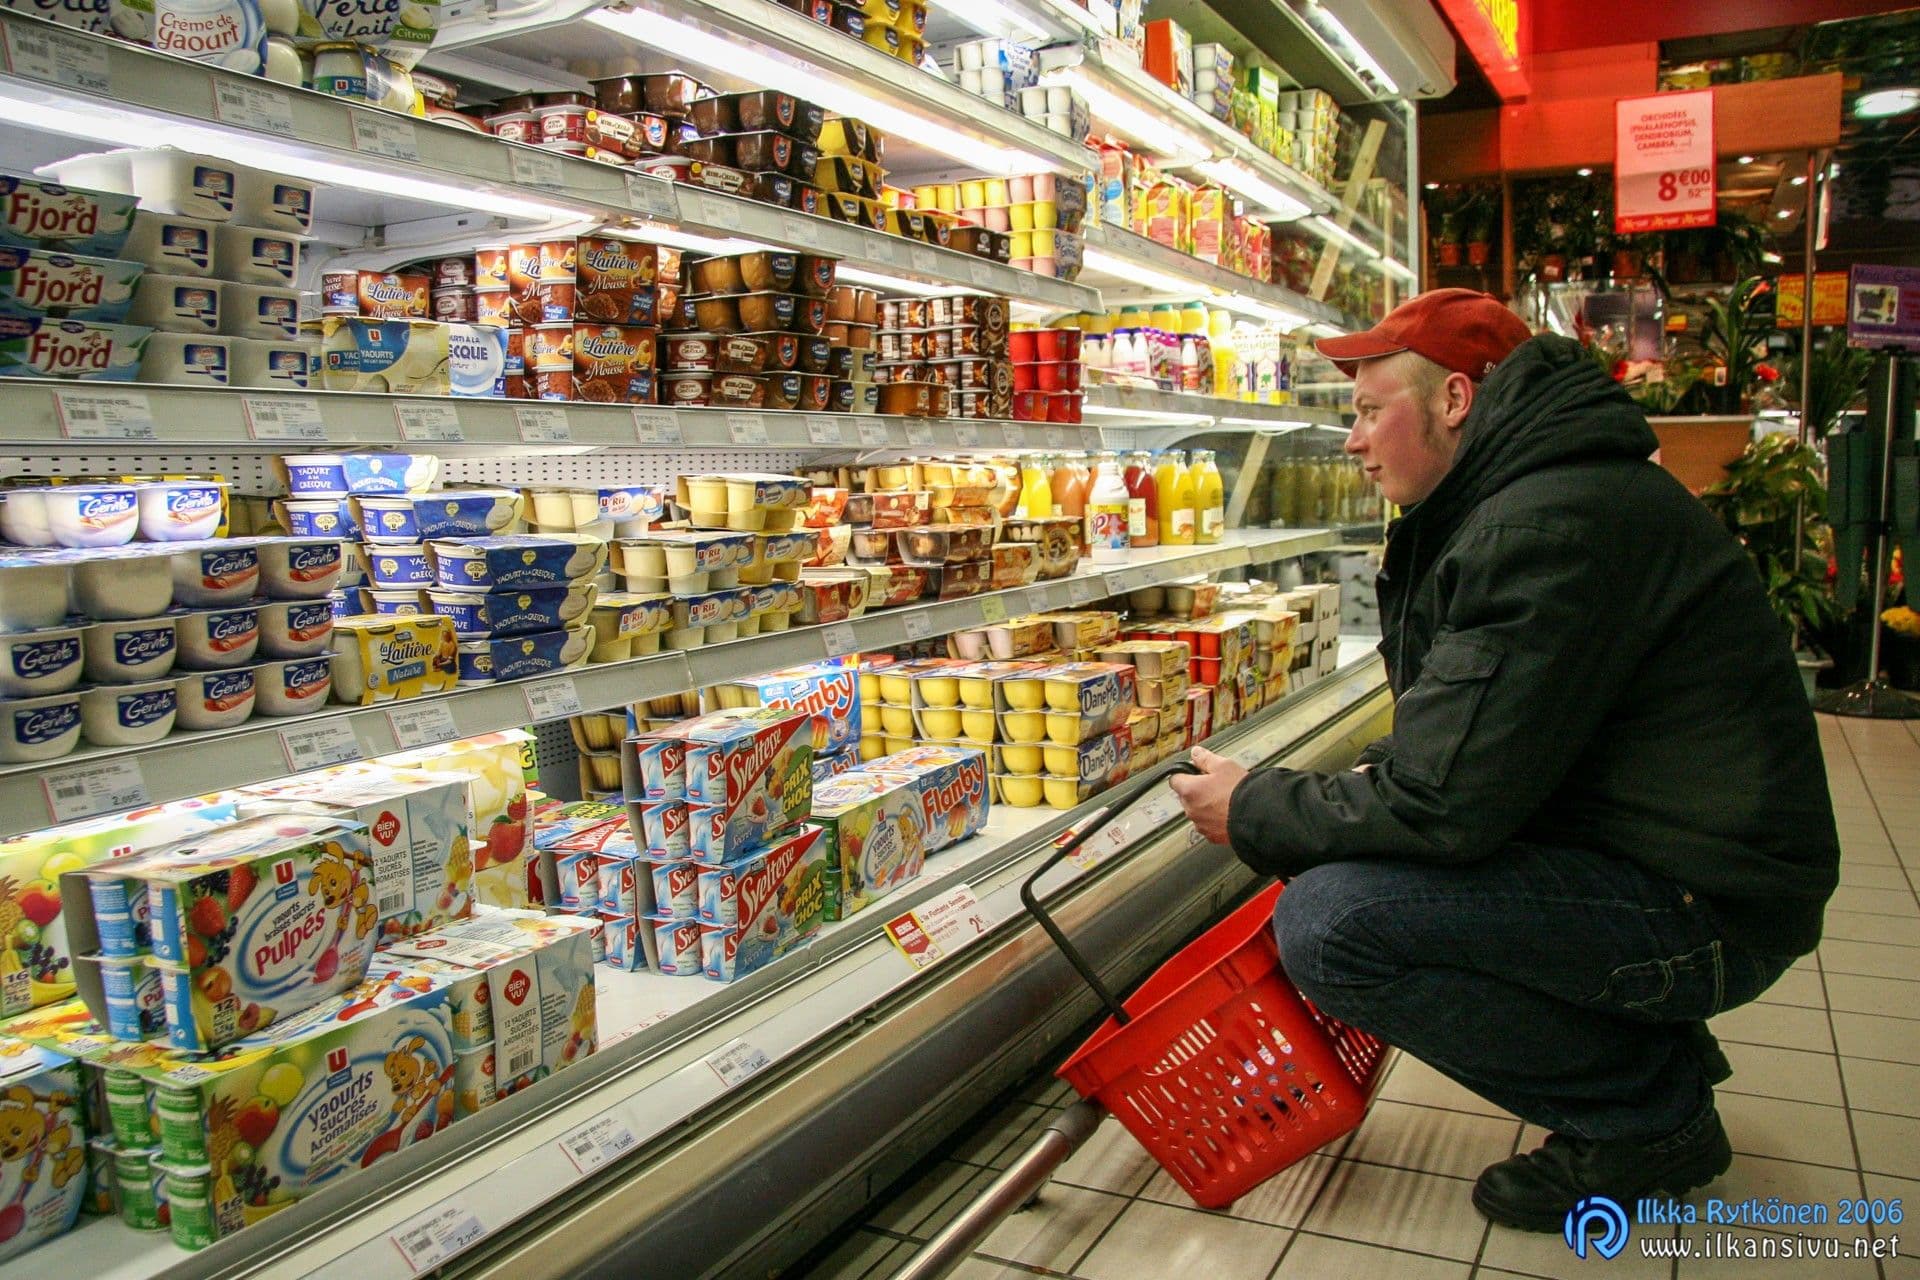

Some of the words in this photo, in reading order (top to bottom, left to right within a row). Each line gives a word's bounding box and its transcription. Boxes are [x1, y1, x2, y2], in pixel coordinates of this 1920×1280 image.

[161, 12, 214, 32] Crème
[216, 14, 233, 28] de
[343, 18, 393, 36] Lait
[396, 28, 432, 41] Citron
[1658, 171, 1677, 201] 8
[8, 193, 98, 236] Fjord
[588, 251, 639, 272] Laitière
[15, 266, 105, 306] Fjord
[26, 333, 113, 373] Fjord
[361, 350, 394, 360] YAOURTS
[584, 336, 635, 358] Laitière
[497, 379, 504, 389] 4
[297, 466, 332, 476] YAOURT
[84, 495, 130, 518] Gervita
[172, 492, 219, 514] Gervita
[612, 496, 625, 507] Riz
[208, 553, 252, 576] Gervita
[295, 547, 335, 570] Gervita
[214, 615, 255, 639] Gervita
[294, 607, 332, 631] Gervita
[20, 642, 73, 669] Gervita
[123, 632, 169, 657] Gervita
[382, 641, 433, 665] Laitière
[210, 671, 251, 698] Gervita
[290, 661, 329, 688] Gervita
[392, 664, 423, 681] Nature
[126, 694, 173, 719] Gervita
[768, 671, 854, 720] anby
[24, 706, 75, 736] Gervita
[727, 728, 782, 807] Sveltesse
[783, 757, 809, 797] PRIX
[784, 780, 812, 814] CHOC
[922, 755, 985, 833] Flanby
[877, 809, 884, 822] U
[379, 829, 395, 840] VU!
[379, 851, 407, 864] YAOURTS
[275, 861, 294, 885] U
[375, 868, 411, 882] ROMATISÉS
[740, 846, 794, 929] Sveltesse
[795, 871, 823, 911] PRIX
[273, 901, 300, 927] yaourts
[794, 892, 823, 928] CHOC
[255, 907, 326, 977] Pulpés
[6, 971, 29, 983] 16
[214, 998, 234, 1012] 12
[511, 1007, 537, 1025] YAOURTS
[503, 1024, 540, 1047] AROMATISÉS
[510, 1019, 532, 1035] SUCRÉS
[327, 1048, 347, 1073] U
[308, 1070, 374, 1132] yaourts
[310, 1099, 378, 1154] Aromatisés
[320, 1094, 366, 1135] sucrés
